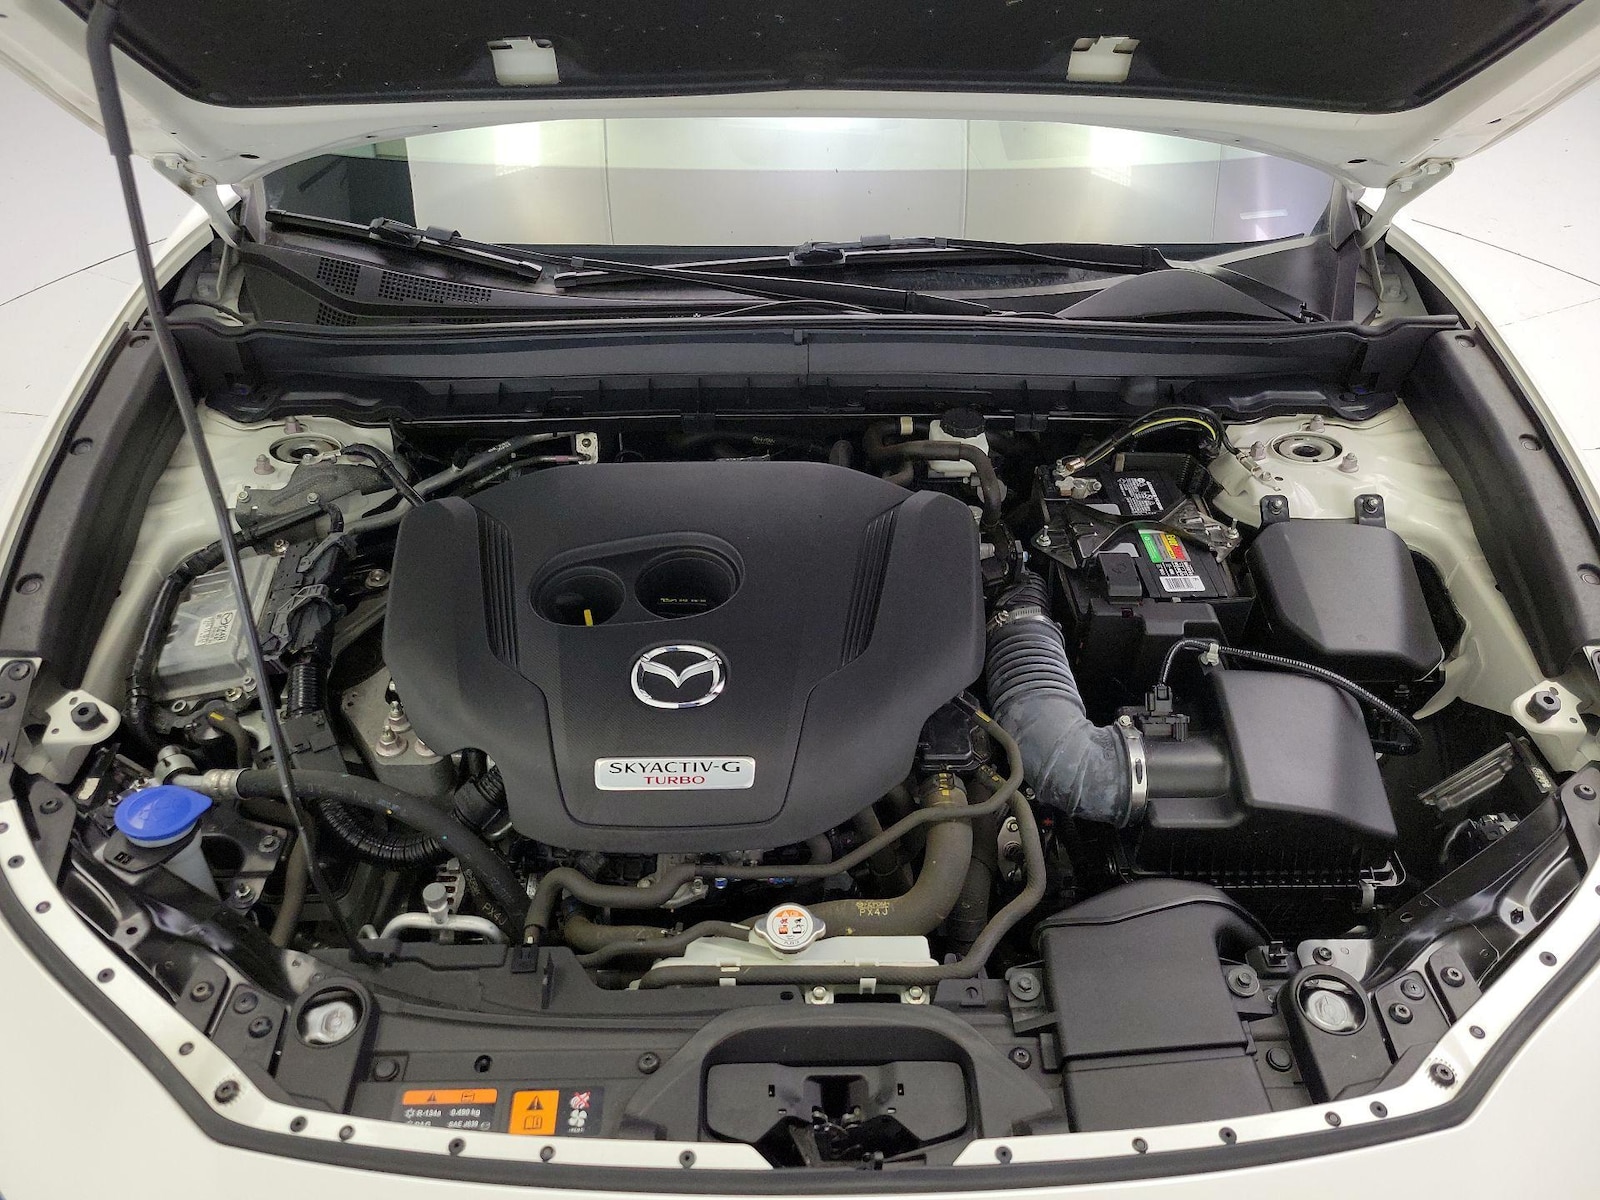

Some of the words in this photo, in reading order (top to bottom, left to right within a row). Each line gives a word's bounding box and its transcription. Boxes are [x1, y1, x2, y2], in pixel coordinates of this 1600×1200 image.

[609, 761, 741, 774] SKYACTIV-G
[644, 775, 705, 785] TURBO
[859, 908, 888, 917] PX4J
